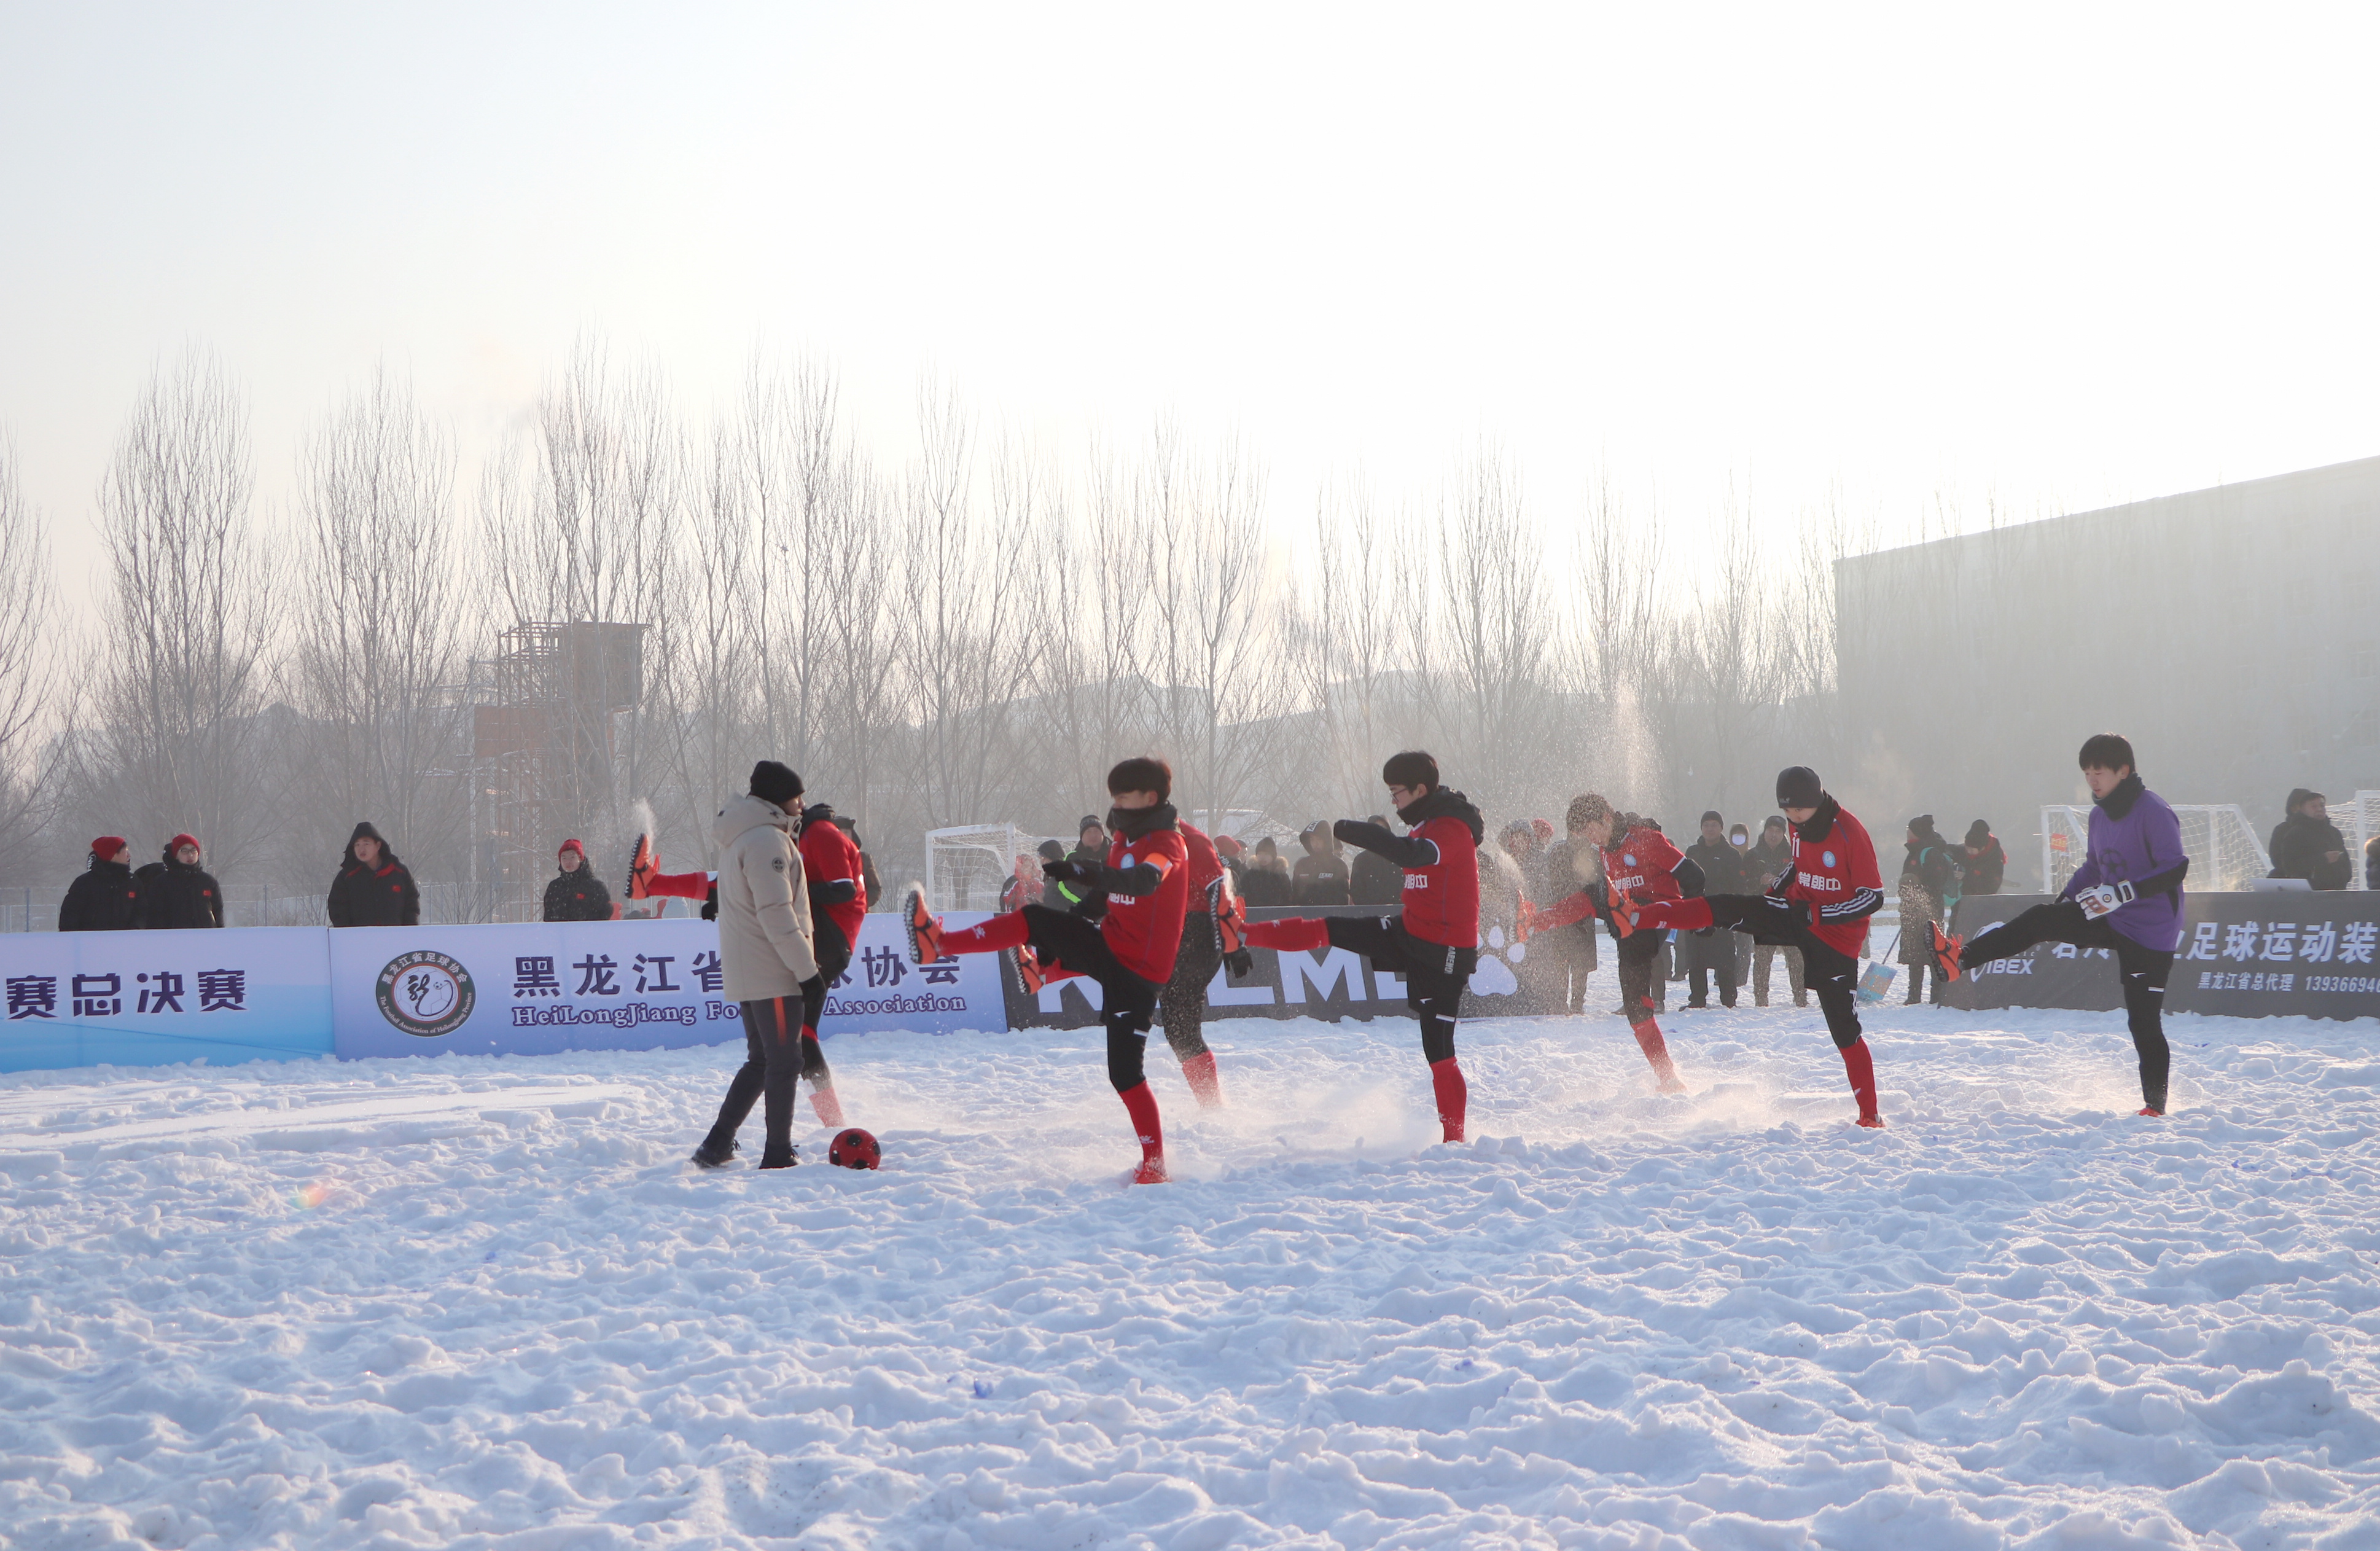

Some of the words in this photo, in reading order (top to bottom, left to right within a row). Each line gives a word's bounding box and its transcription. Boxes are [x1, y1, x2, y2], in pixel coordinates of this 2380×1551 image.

[381, 952, 468, 985] 黑龙江省足球协会
[513, 945, 961, 998] 黑龙江省协会
[2197, 971, 2295, 992] 黑龙江省总代理
[6, 968, 248, 1020] 赛总决赛
[383, 1004, 400, 1024] Football
[399, 1021, 429, 1034] Association
[462, 991, 472, 1013] Province
[512, 1002, 696, 1028] HeiLongJiang
[824, 993, 967, 1016] Association
